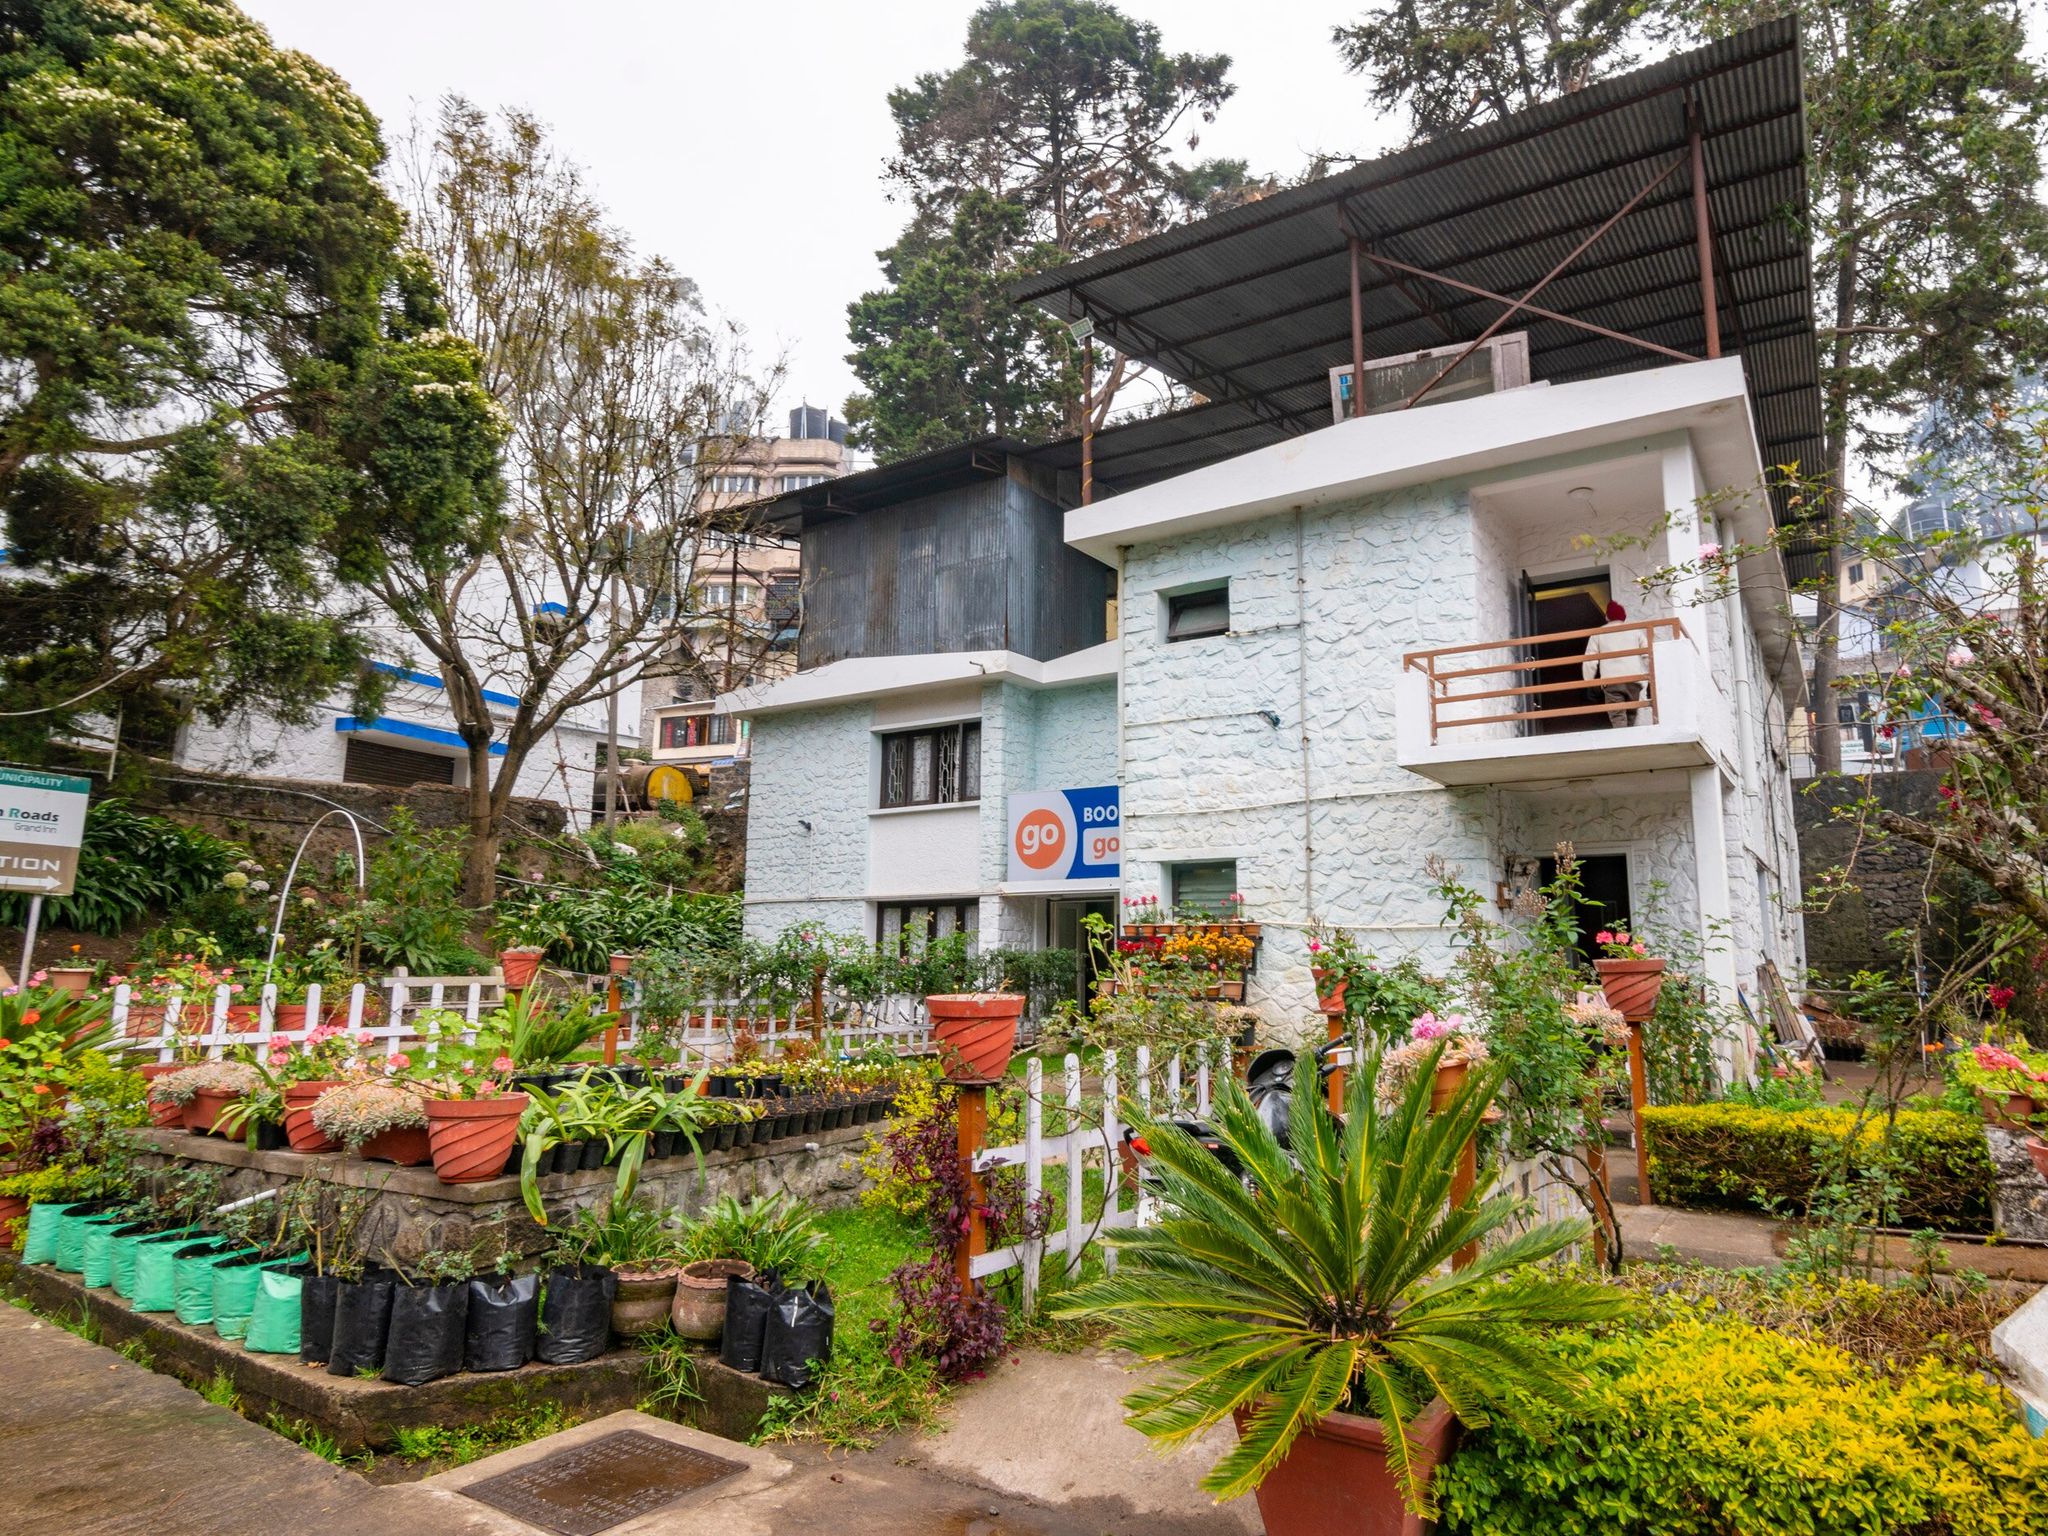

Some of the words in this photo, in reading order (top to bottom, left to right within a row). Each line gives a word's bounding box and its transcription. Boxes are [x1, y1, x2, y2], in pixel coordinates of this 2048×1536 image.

[8, 807, 60, 822] Roads
[14, 822, 41, 833] Grand
[43, 825, 57, 834] Inn
[1021, 823, 1060, 855] go
[1093, 837, 1120, 859] go
